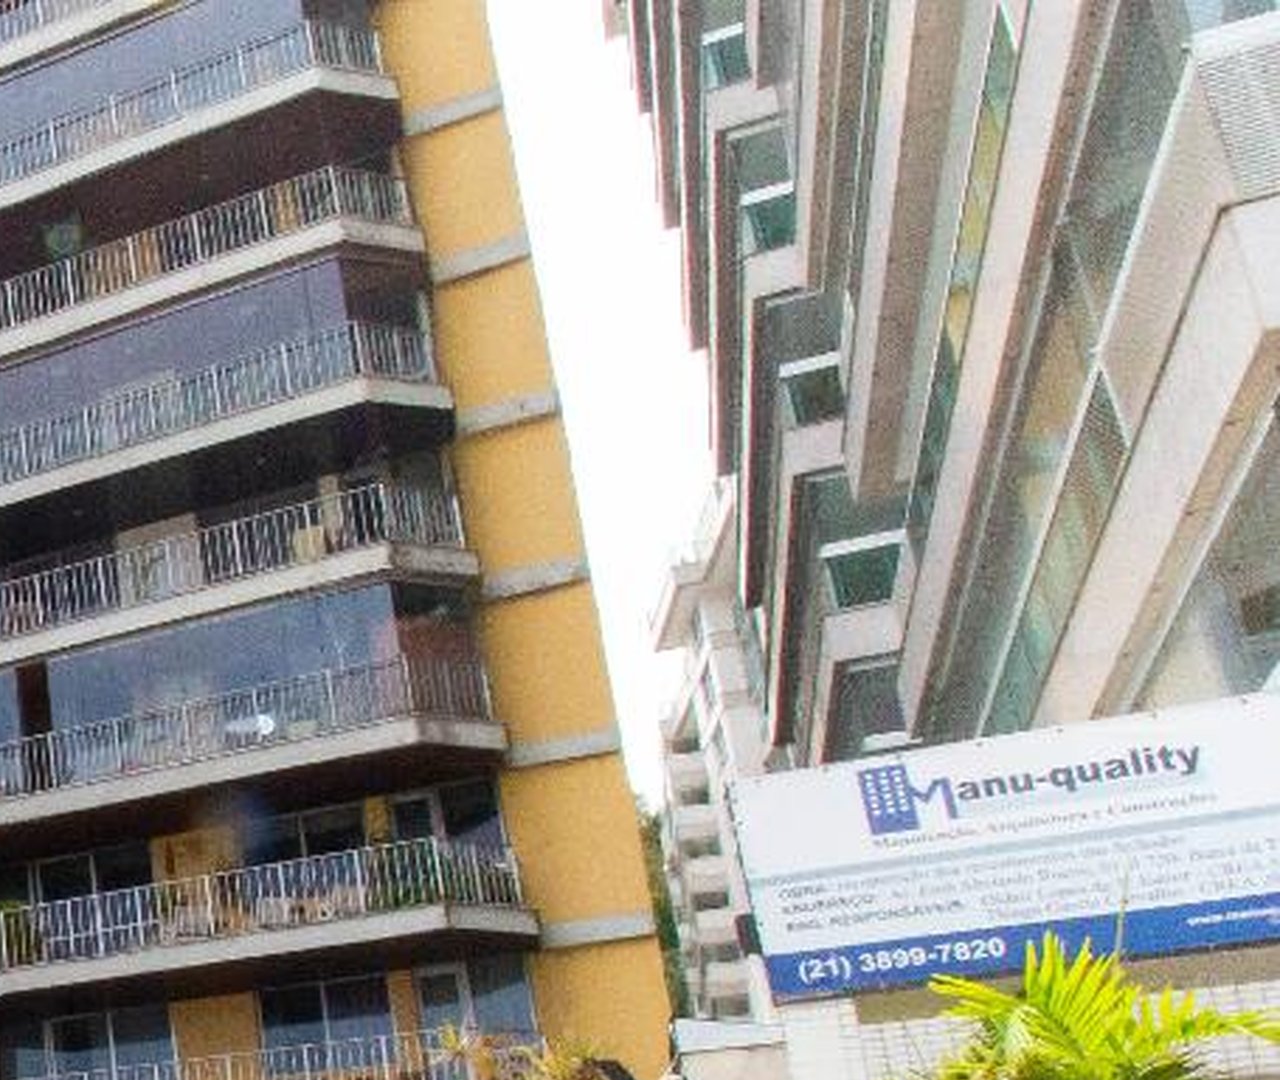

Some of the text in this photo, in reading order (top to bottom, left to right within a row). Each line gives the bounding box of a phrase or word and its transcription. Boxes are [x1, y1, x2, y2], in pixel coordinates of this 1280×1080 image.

[904, 743, 1201, 819] Manu-quality
[798, 936, 1007, 985] (21) 3899-7820
